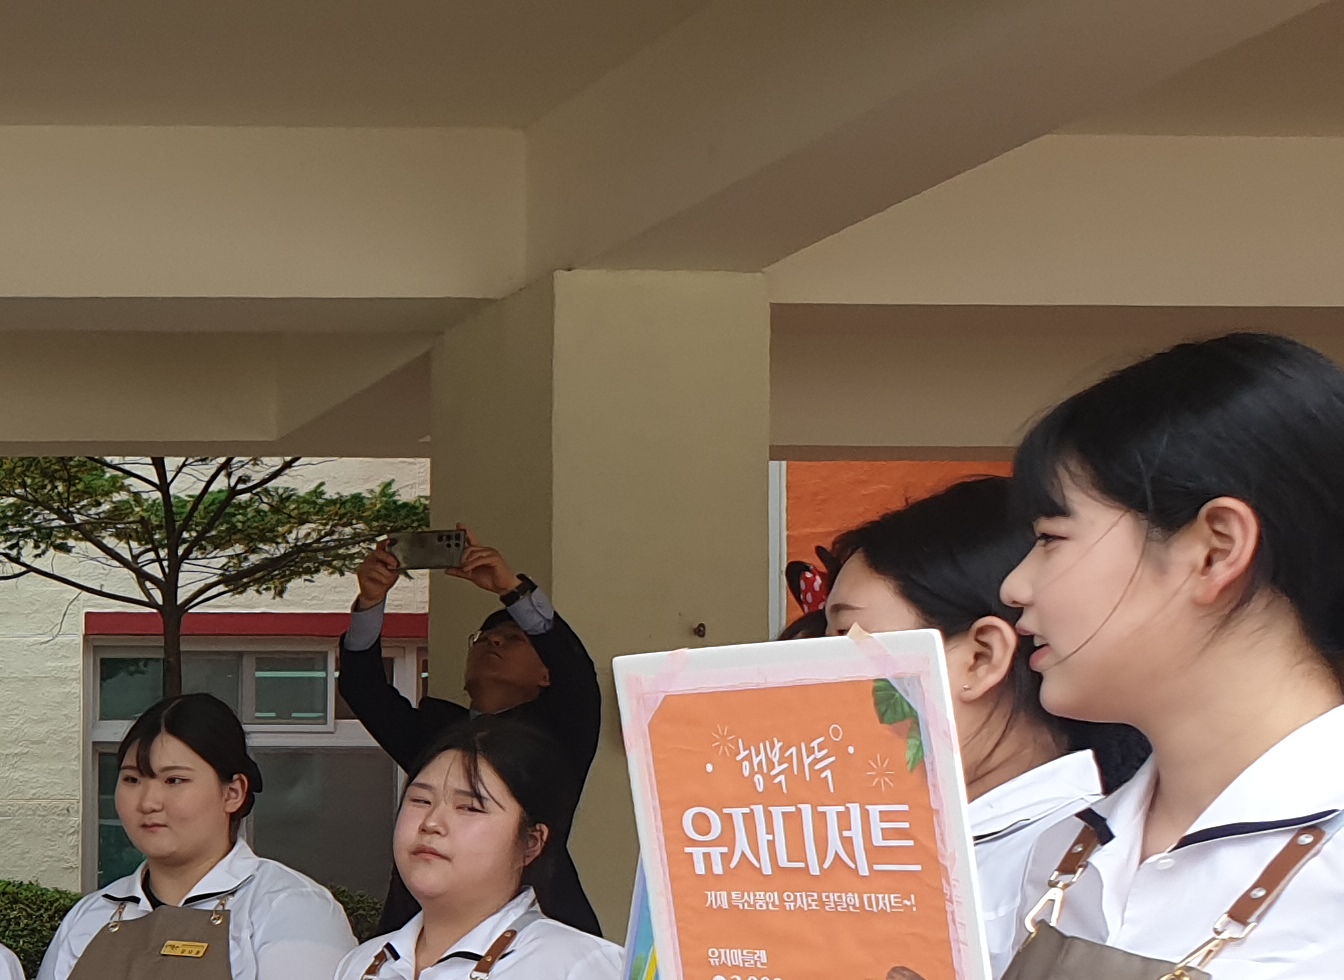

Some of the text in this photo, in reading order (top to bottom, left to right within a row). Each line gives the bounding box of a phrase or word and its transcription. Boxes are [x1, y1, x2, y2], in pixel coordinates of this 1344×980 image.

[736, 737, 836, 794] 행복가득
[681, 802, 922, 876] 유자디저트
[822, 892, 860, 912] 달달한
